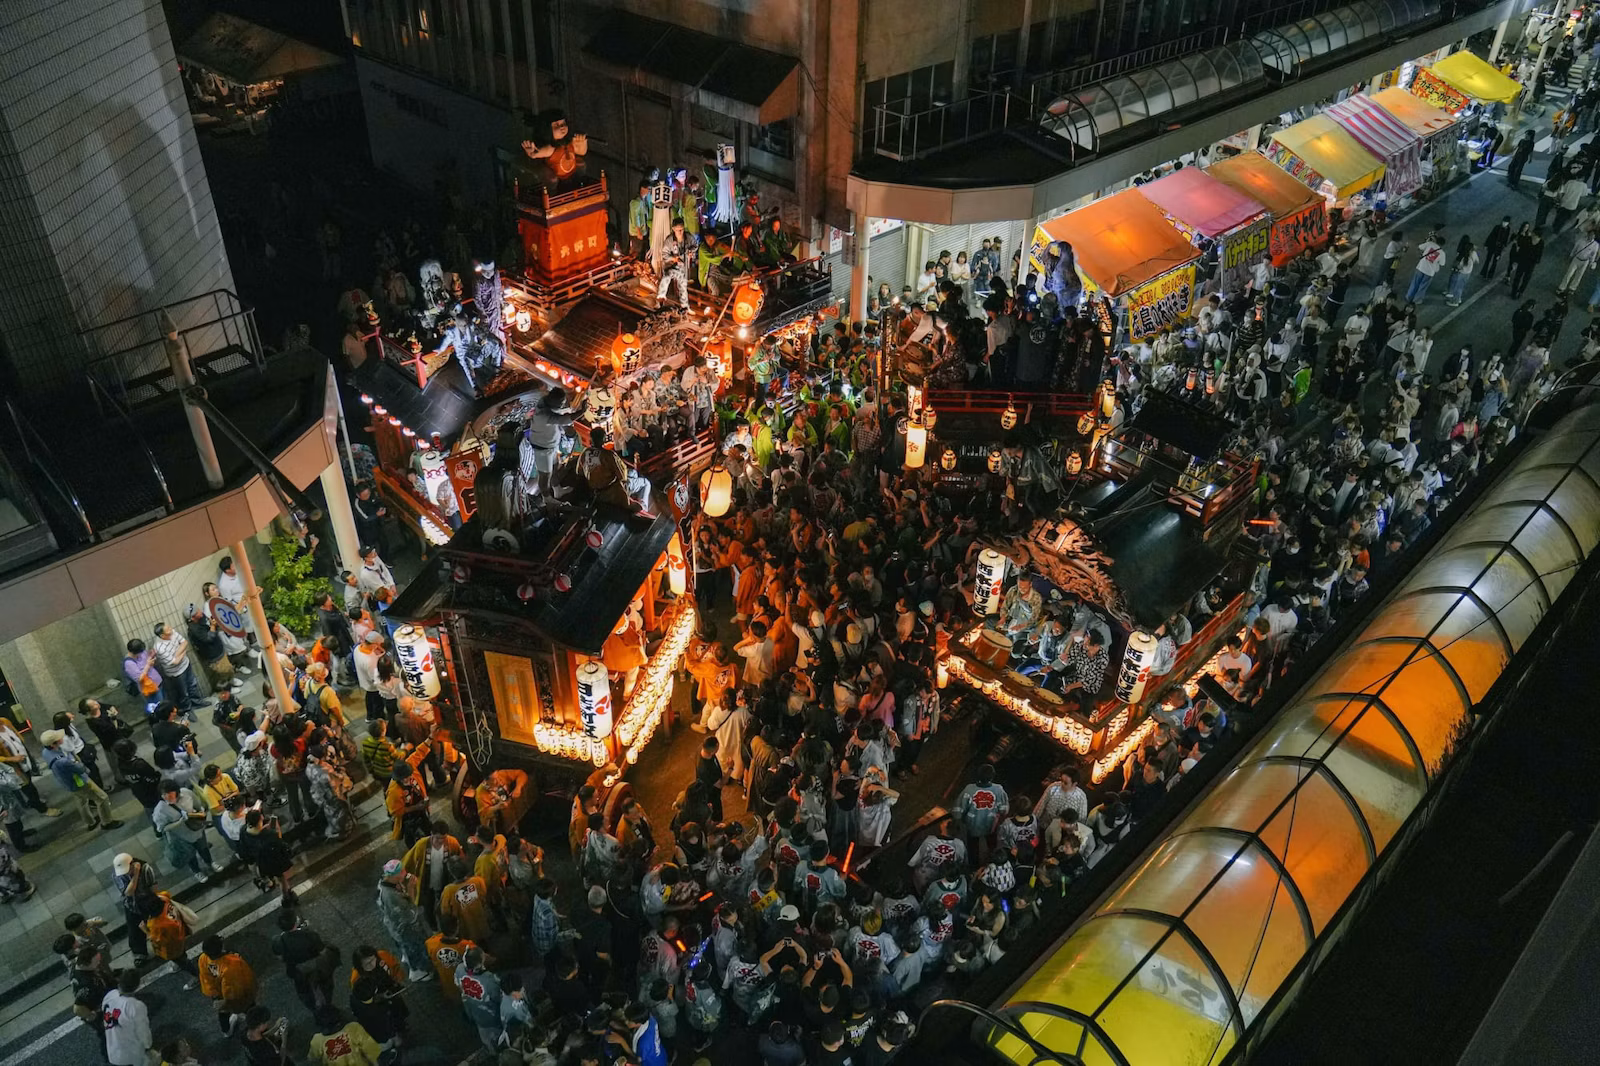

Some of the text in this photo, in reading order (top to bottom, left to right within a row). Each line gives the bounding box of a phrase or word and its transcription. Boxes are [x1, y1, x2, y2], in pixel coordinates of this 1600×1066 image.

[1224, 228, 1268, 269] バナナチョコ
[217, 607, 241, 629] 30
